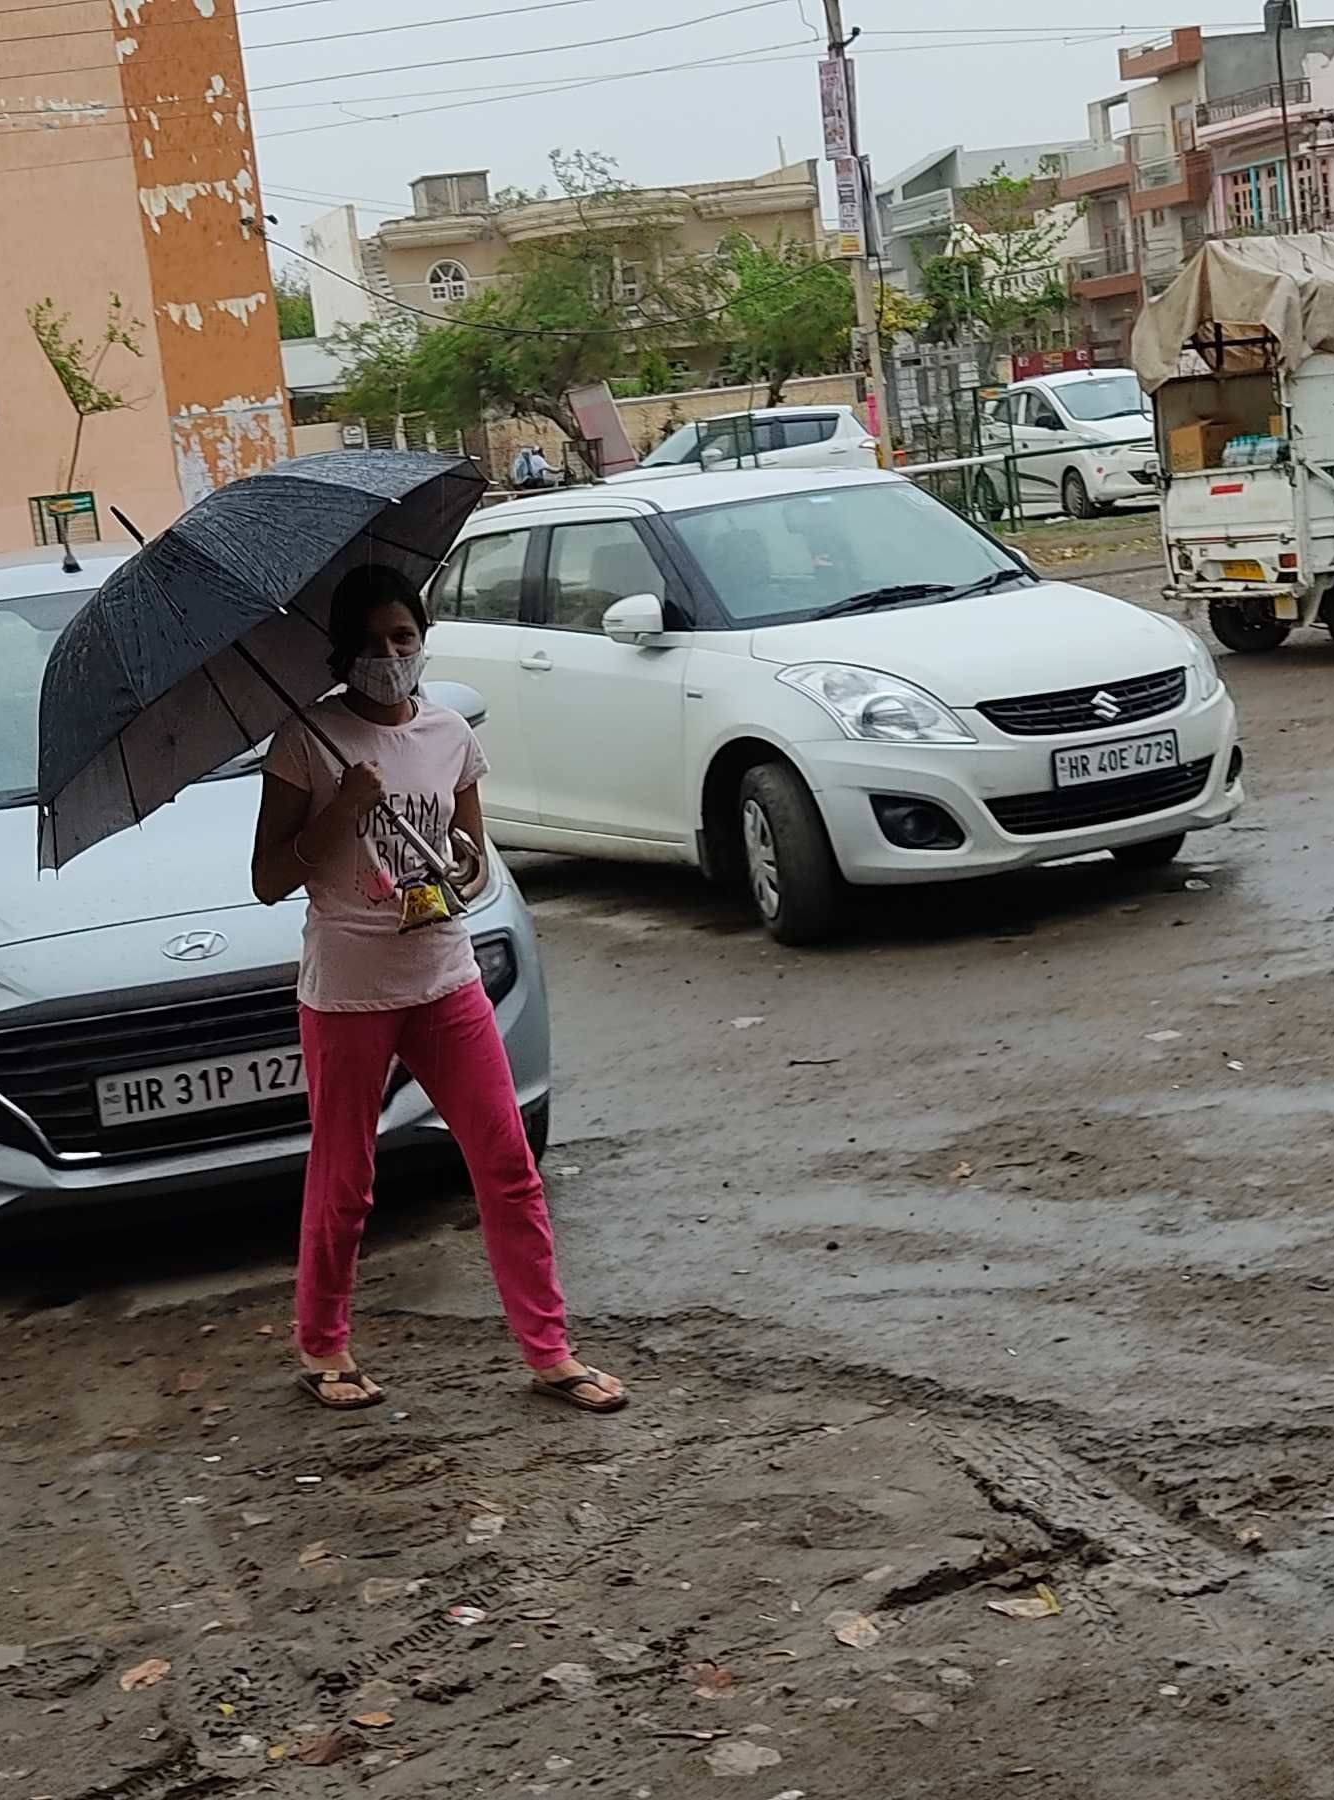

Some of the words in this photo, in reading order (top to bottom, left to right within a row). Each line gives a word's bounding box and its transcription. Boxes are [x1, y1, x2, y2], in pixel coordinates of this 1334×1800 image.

[1068, 754, 1091, 779] HR
[1098, 748, 1130, 774] 40E
[1134, 739, 1174, 766] 4729
[124, 1077, 166, 1115] HR
[174, 1065, 234, 1106] 31P
